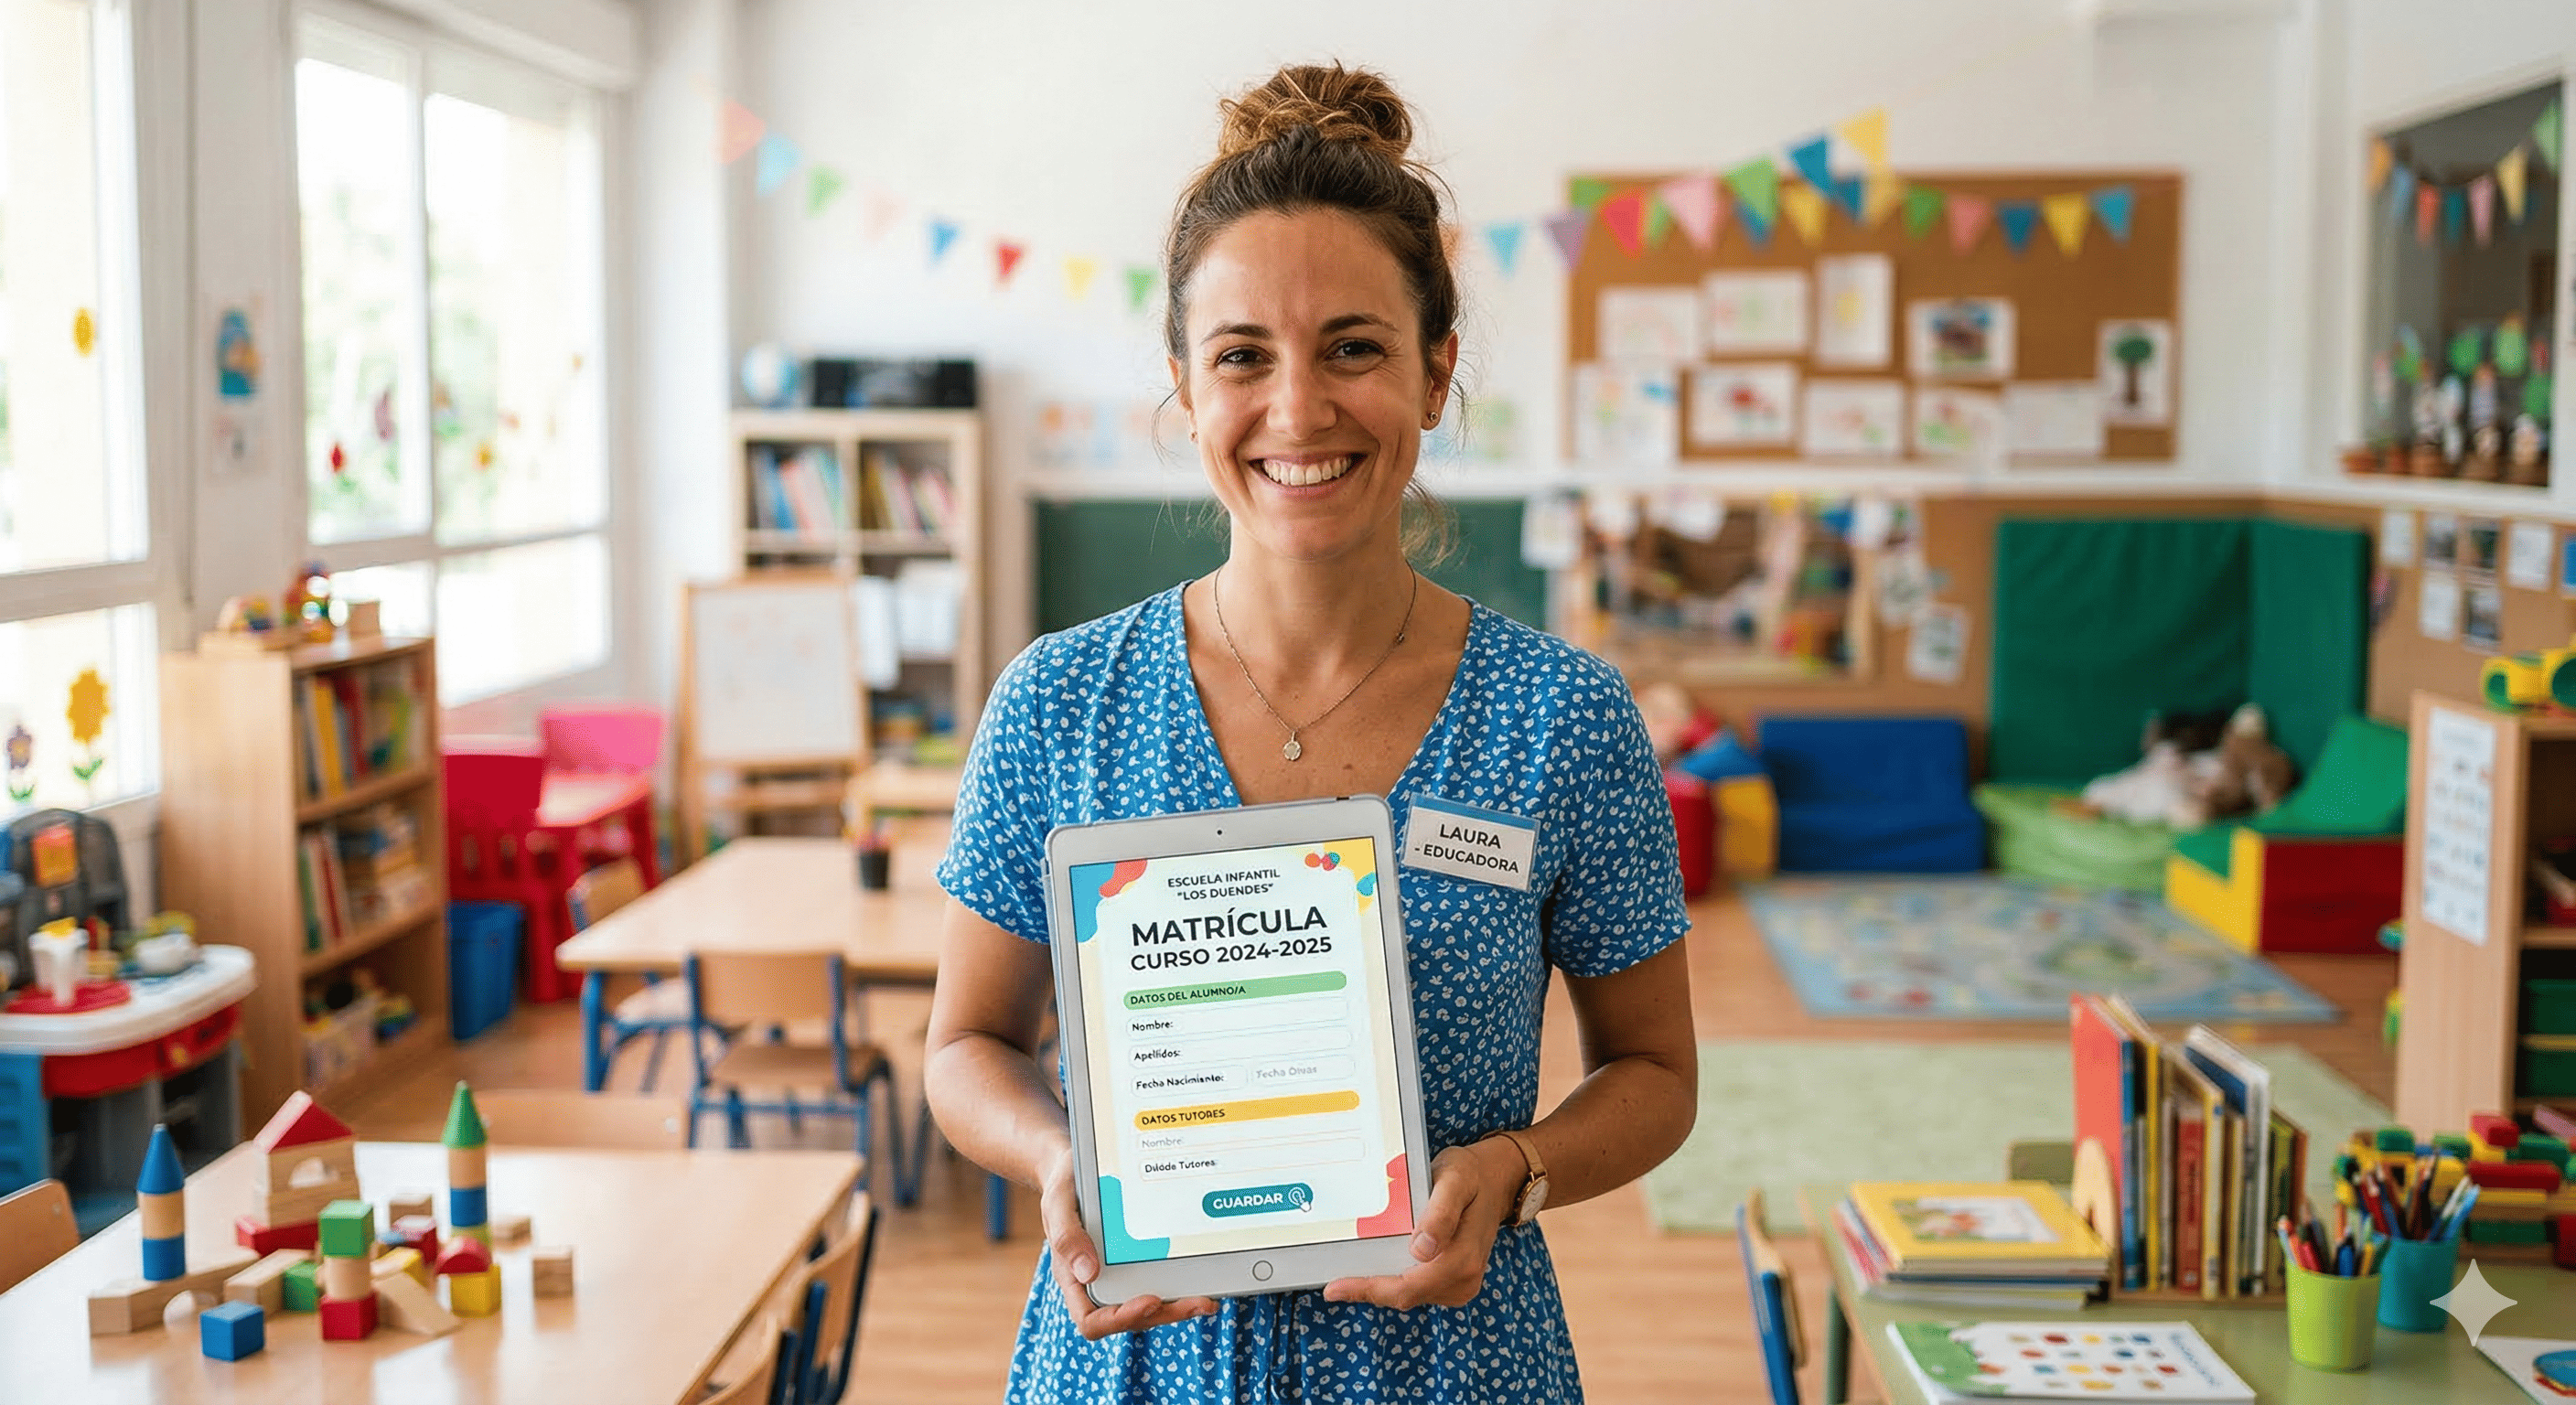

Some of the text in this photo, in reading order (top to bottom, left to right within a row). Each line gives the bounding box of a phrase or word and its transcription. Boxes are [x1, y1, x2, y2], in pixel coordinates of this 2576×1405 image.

[1439, 823, 1501, 849] LAURA
[1423, 843, 1519, 874] EDUCADORA
[1167, 869, 1281, 887] ESCUELA INFANTIL
[1177, 883, 1274, 900] "LOS DUENDES"
[1132, 906, 1327, 947] MATRÍCULA
[1131, 937, 1332, 971] CURSO 2024-2025
[1130, 986, 1246, 1004] DATOS DEL ALUMNO/A
[1132, 1019, 1174, 1032] Nombre:
[1141, 1109, 1226, 1125] DATOS TUTORES
[1212, 1193, 1283, 1209] GUARDAR
